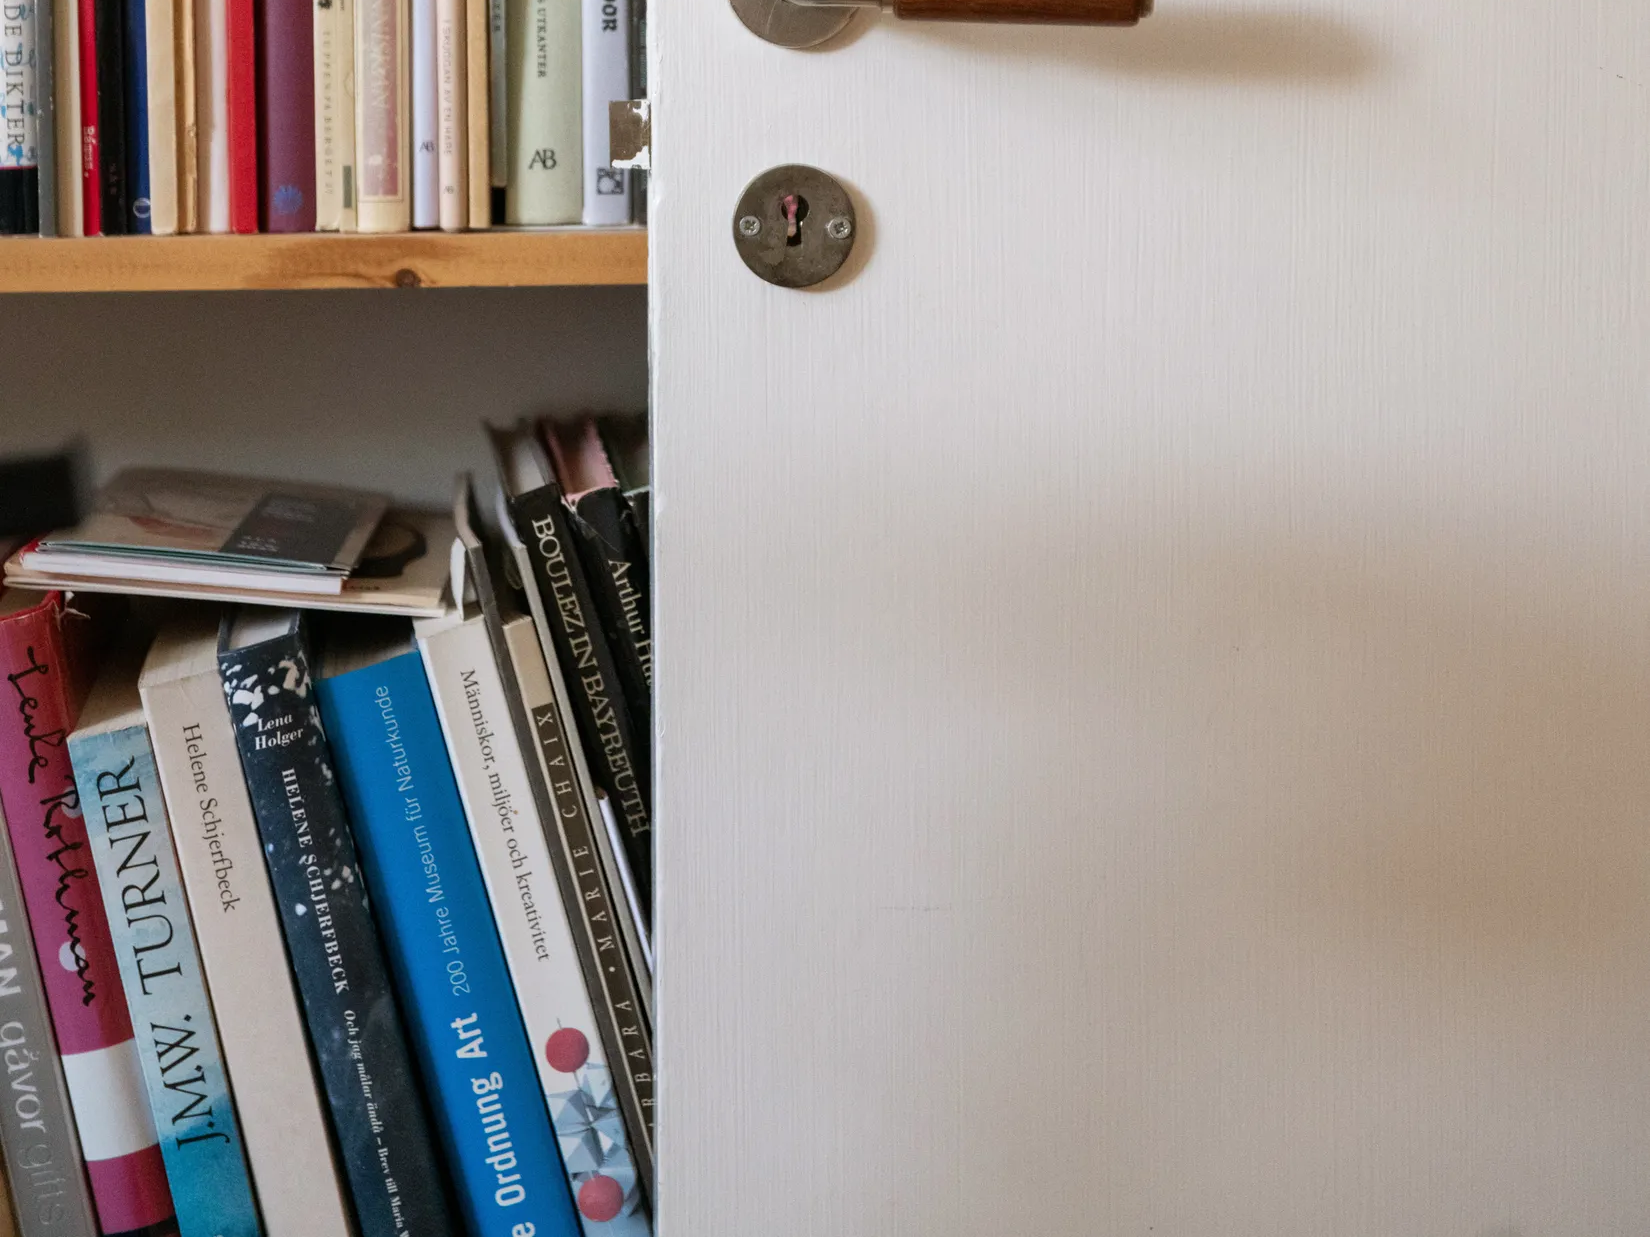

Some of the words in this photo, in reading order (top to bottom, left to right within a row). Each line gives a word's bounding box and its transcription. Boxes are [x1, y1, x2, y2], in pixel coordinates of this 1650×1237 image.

[537, 8, 547, 79] UTKANTER
[5, 49, 25, 147] DIKTER
[528, 149, 557, 170] AB
[531, 514, 587, 634] BOULEZ
[608, 559, 646, 635] Arthur
[569, 634, 599, 675] IN
[254, 727, 304, 751] Holger
[257, 714, 292, 733] Lena
[375, 684, 415, 793] Naturkunde
[460, 668, 496, 772] Människor,
[535, 711, 578, 819] CHAIX
[580, 669, 651, 838] BAYREUTH
[182, 723, 208, 794] Helene
[200, 798, 241, 913] Schjerfbeck
[404, 796, 423, 823] für
[487, 772, 516, 836] miljöer
[96, 756, 184, 995] TURNER
[281, 767, 313, 848] HELENE
[303, 853, 350, 995] SCHJERFBECK
[413, 824, 446, 905] Museum
[506, 837, 529, 871] och
[515, 871, 551, 963] kreativitet
[572, 844, 616, 952] MARIE
[435, 906, 461, 957] Jahre
[445, 959, 471, 998] 200
[343, 1010, 359, 1036] Och
[347, 1038, 363, 1061] jag
[450, 1012, 488, 1060] Art
[150, 1014, 230, 1152] J.M.W.
[356, 1062, 373, 1100] målar
[367, 1101, 385, 1135] ändå
[470, 1070, 527, 1208] Ordnung
[377, 1147, 391, 1176] Brev
[385, 1178, 399, 1195] till
[389, 1195, 404, 1229] Maria
